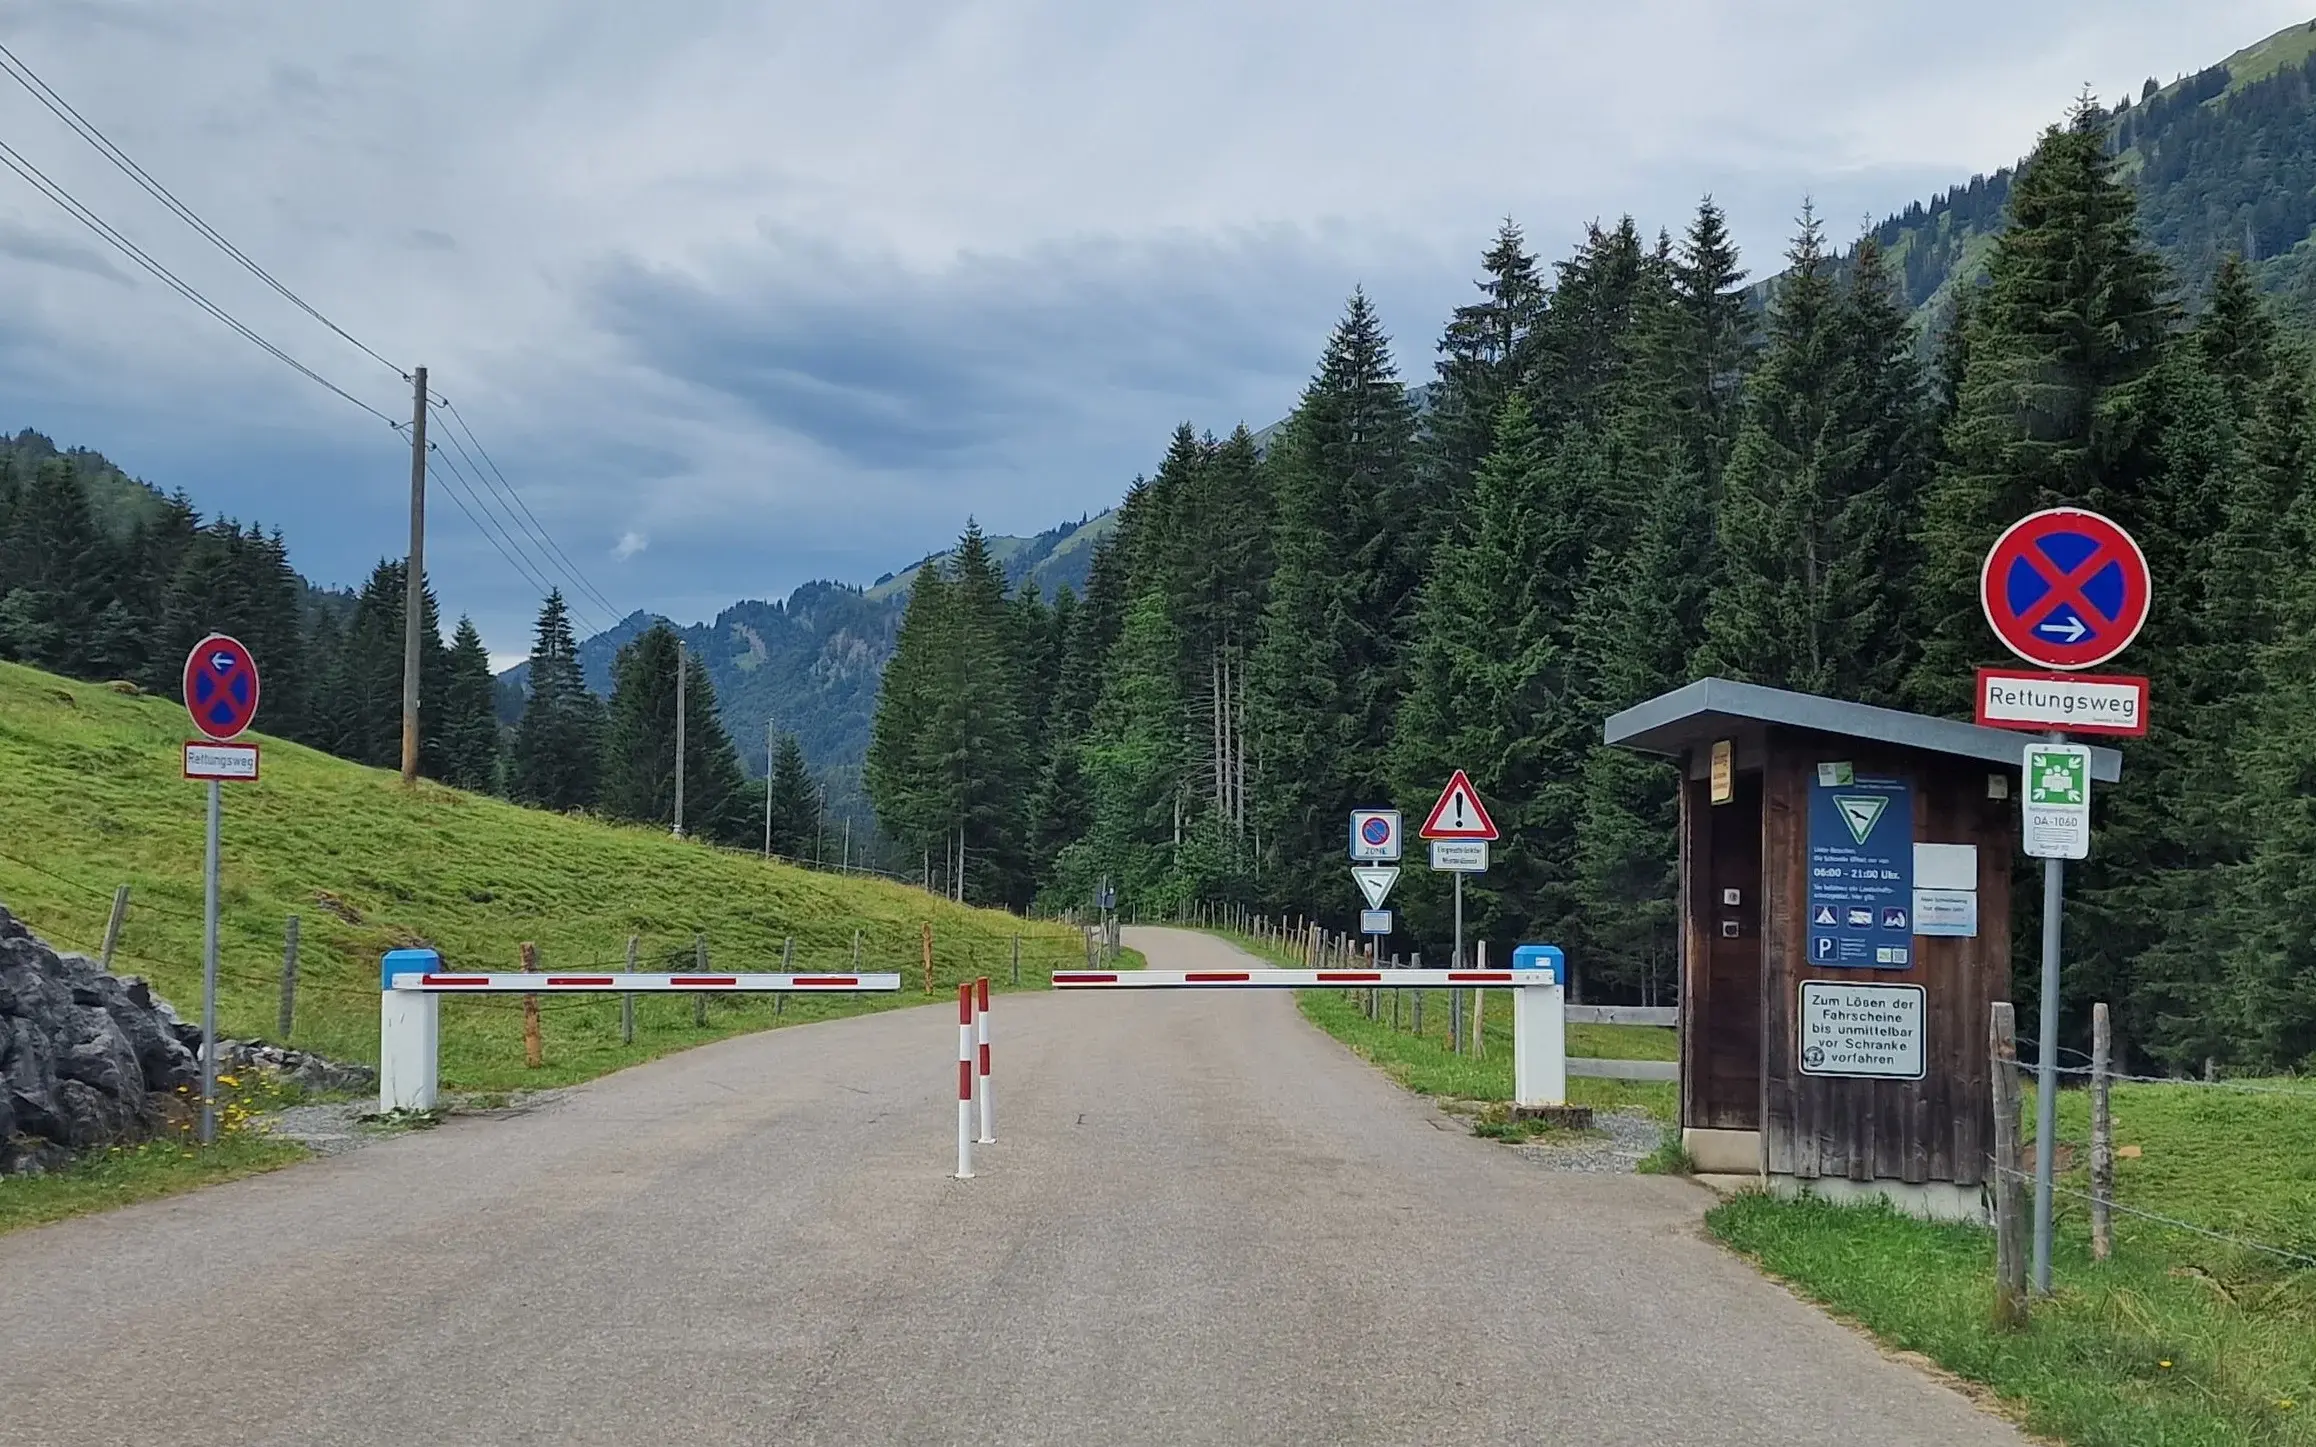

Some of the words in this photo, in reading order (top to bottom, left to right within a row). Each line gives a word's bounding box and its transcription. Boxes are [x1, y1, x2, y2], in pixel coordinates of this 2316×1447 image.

[1990, 687, 2135, 717] Rettungsweg
[188, 752, 254, 770] Rettungsweg
[1364, 847, 1388, 855] ZONE
[1814, 867, 1841, 878] 06:00
[1851, 869, 1879, 880] 21:00
[1820, 938, 1832, 958] P
[1812, 994, 1840, 1006] Zum
[1846, 996, 1886, 1008] Lösen
[1892, 998, 1914, 1010] der
[1823, 1009, 1903, 1023] Fahrscheine
[1812, 1023, 1831, 1034] bis
[1838, 1025, 1914, 1037] unmittelbar
[1819, 1039, 1838, 1048] vor
[1845, 1038, 1908, 1051] Schranke
[1831, 1053, 1895, 1065] vorfahren
